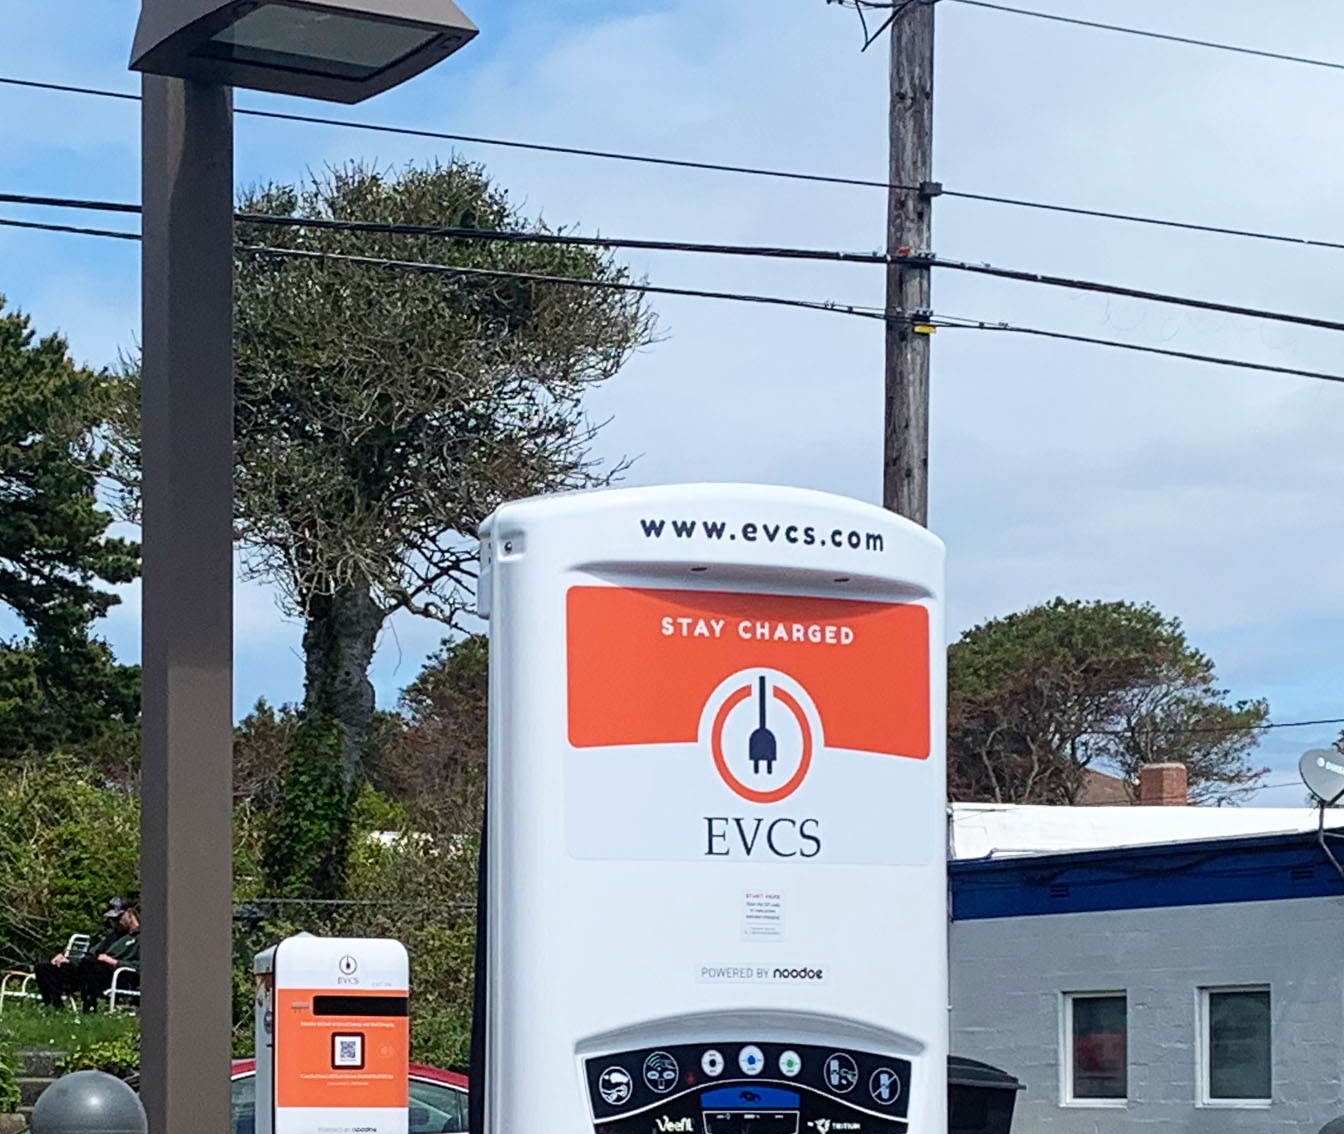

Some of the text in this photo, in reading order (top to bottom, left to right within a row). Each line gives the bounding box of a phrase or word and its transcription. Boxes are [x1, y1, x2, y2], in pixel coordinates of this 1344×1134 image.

[640, 519, 884, 552] www.evcs.com
[661, 616, 855, 645] STAY CHARGED
[703, 816, 821, 858] EVCS
[701, 967, 823, 980] POWERED BY noodoe
